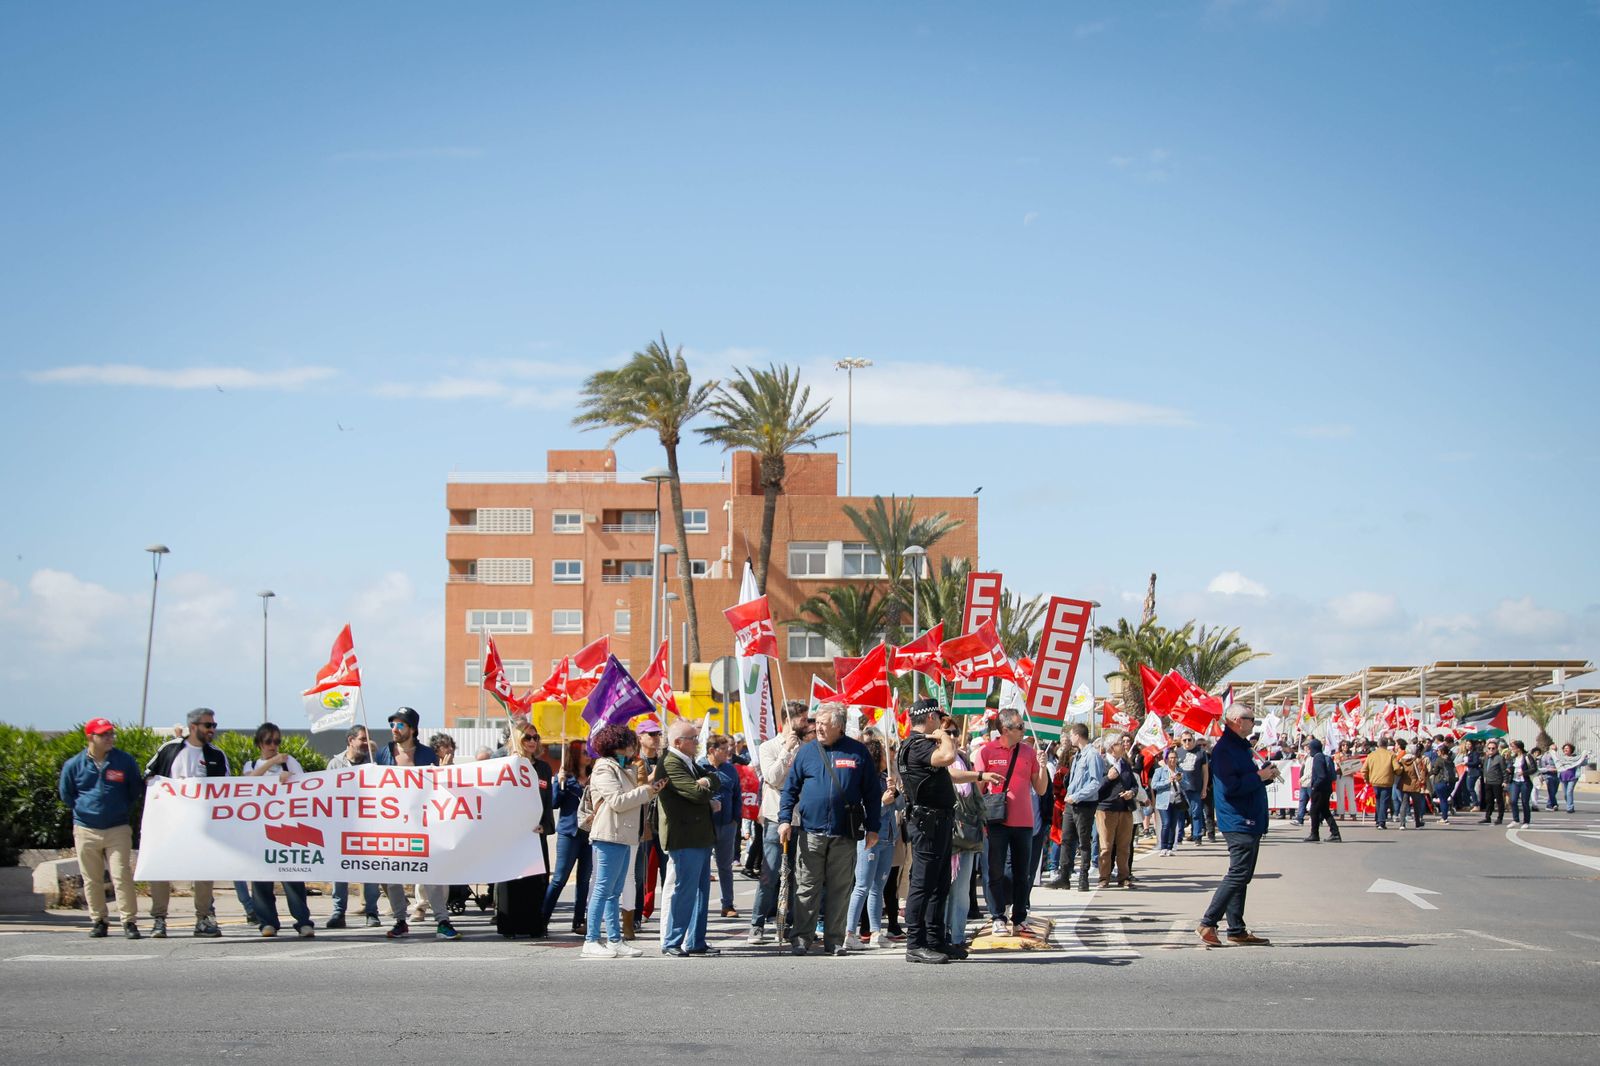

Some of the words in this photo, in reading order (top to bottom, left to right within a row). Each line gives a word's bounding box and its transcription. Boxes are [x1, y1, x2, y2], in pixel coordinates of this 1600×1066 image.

[961, 578, 997, 690] CC
[1031, 603, 1084, 716] CCOO
[155, 777, 324, 800] AUMENTO
[336, 763, 531, 790] PLANTILLAS
[211, 796, 408, 824] DOCENTES,
[422, 796, 482, 827] ¡YA!
[264, 849, 325, 865] USTEA
[345, 836, 410, 852] CCOO
[341, 857, 428, 873] enseñanza
